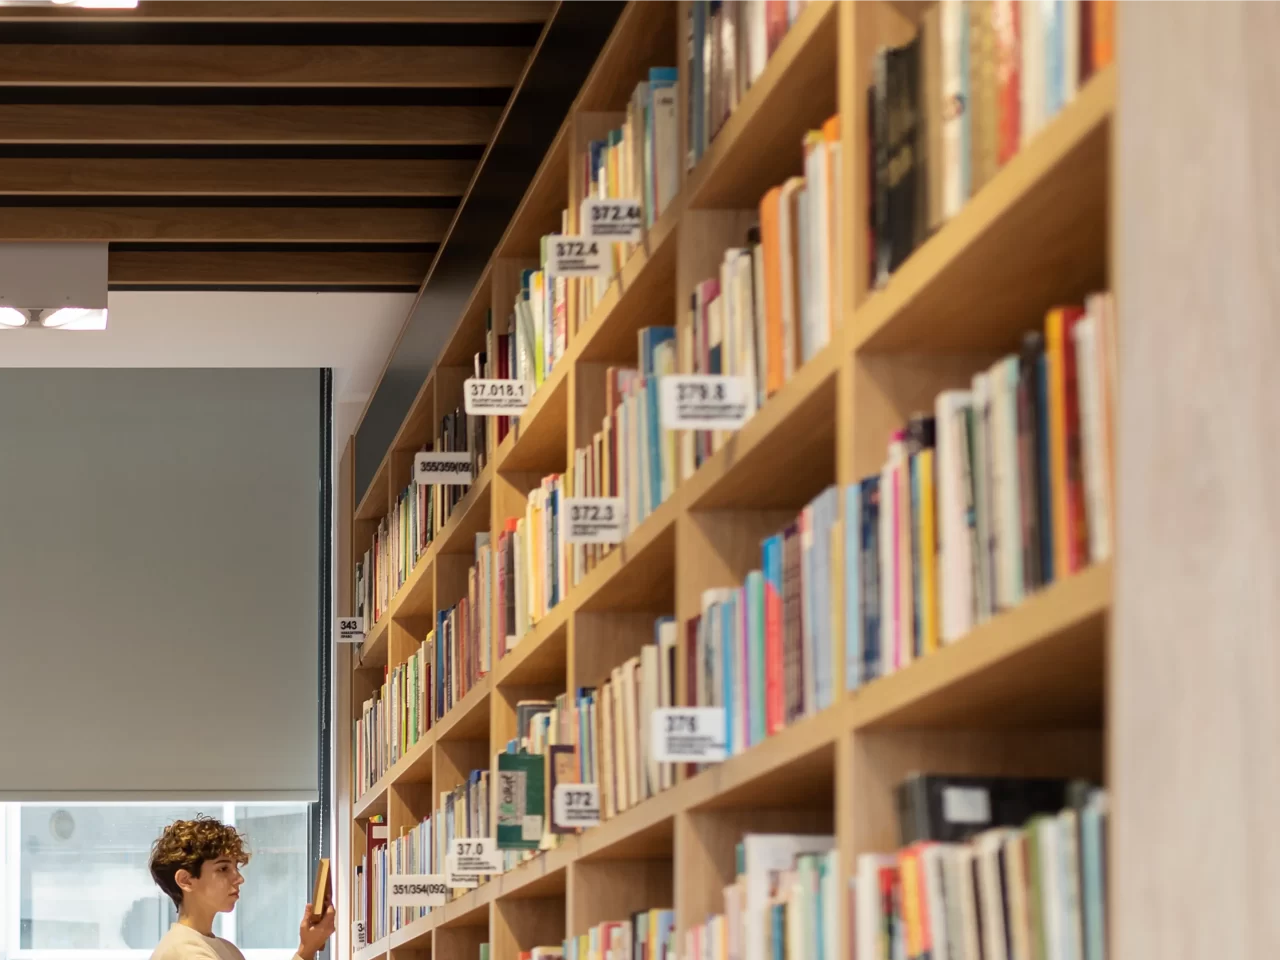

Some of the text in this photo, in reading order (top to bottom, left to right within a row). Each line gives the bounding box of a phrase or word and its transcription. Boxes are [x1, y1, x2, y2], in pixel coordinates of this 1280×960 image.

[471, 384, 524, 397] 37.018.1
[571, 505, 614, 521] 372.3
[340, 620, 357, 630] 343
[565, 791, 591, 806] 372
[457, 843, 483, 856] 37.0
